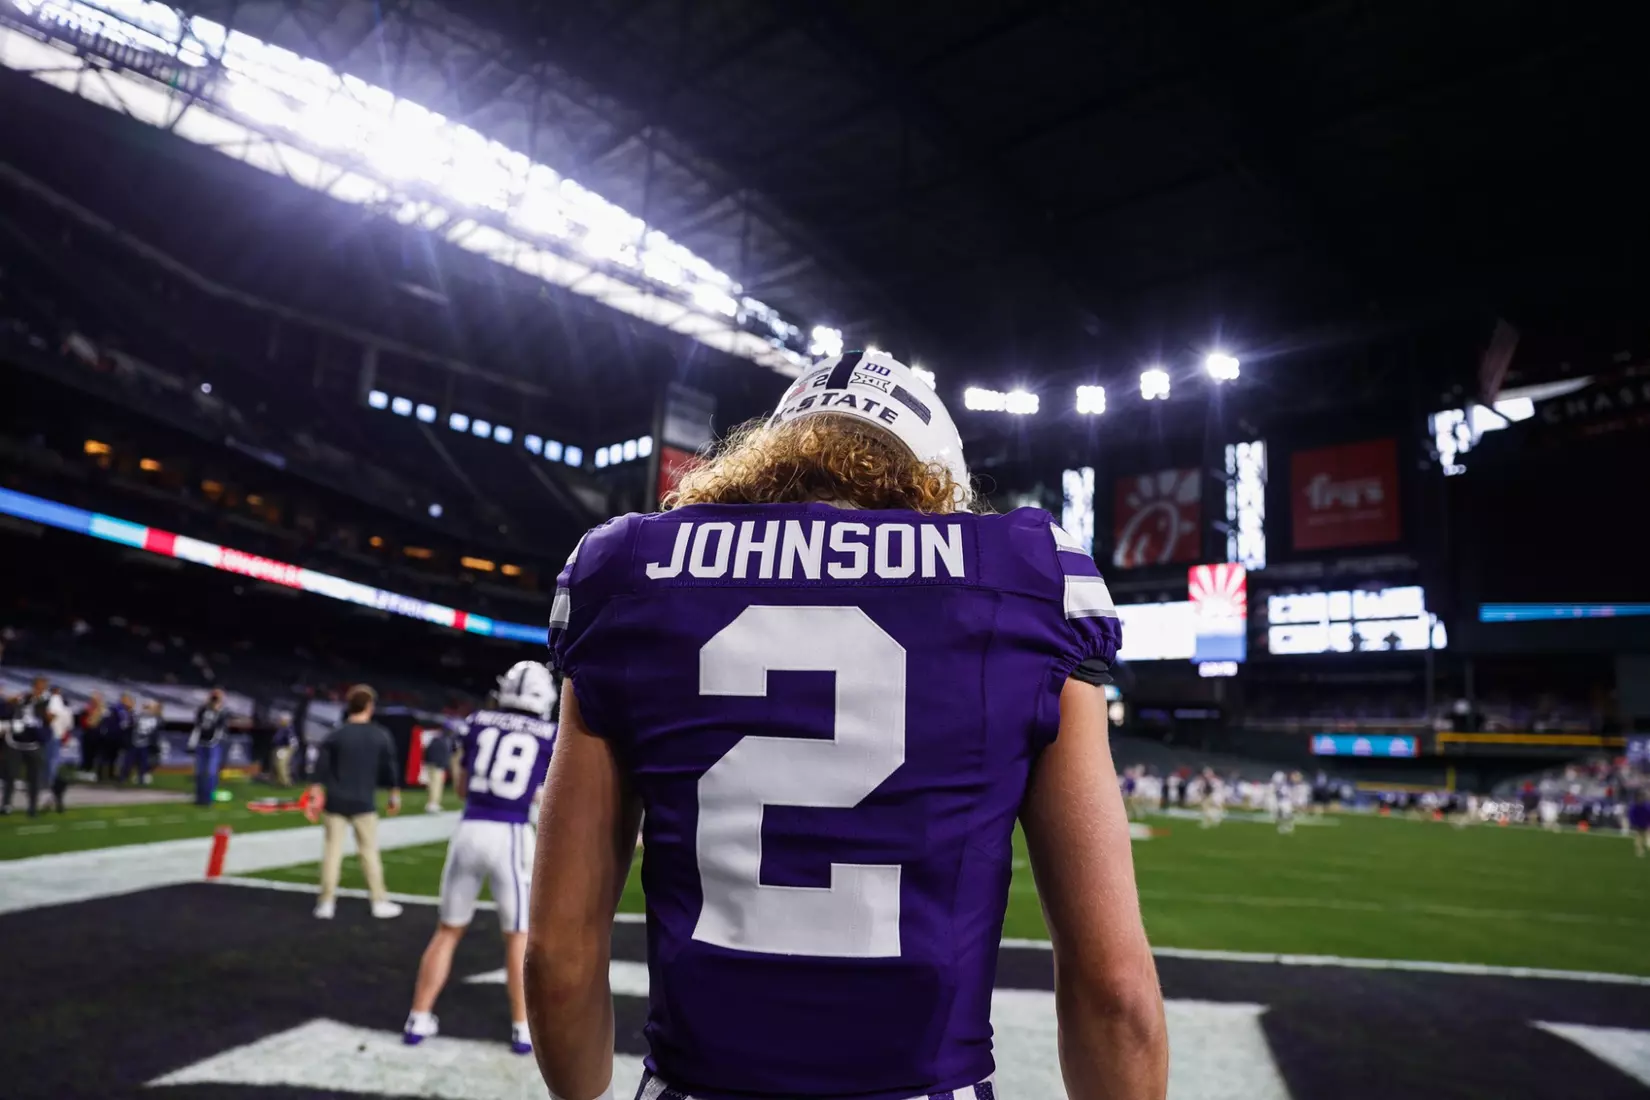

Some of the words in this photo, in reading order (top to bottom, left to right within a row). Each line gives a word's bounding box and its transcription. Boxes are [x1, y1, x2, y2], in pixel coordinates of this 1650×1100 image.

[646, 519, 965, 581] JOHNSON
[468, 726, 540, 801] 18
[691, 604, 907, 958] 2
